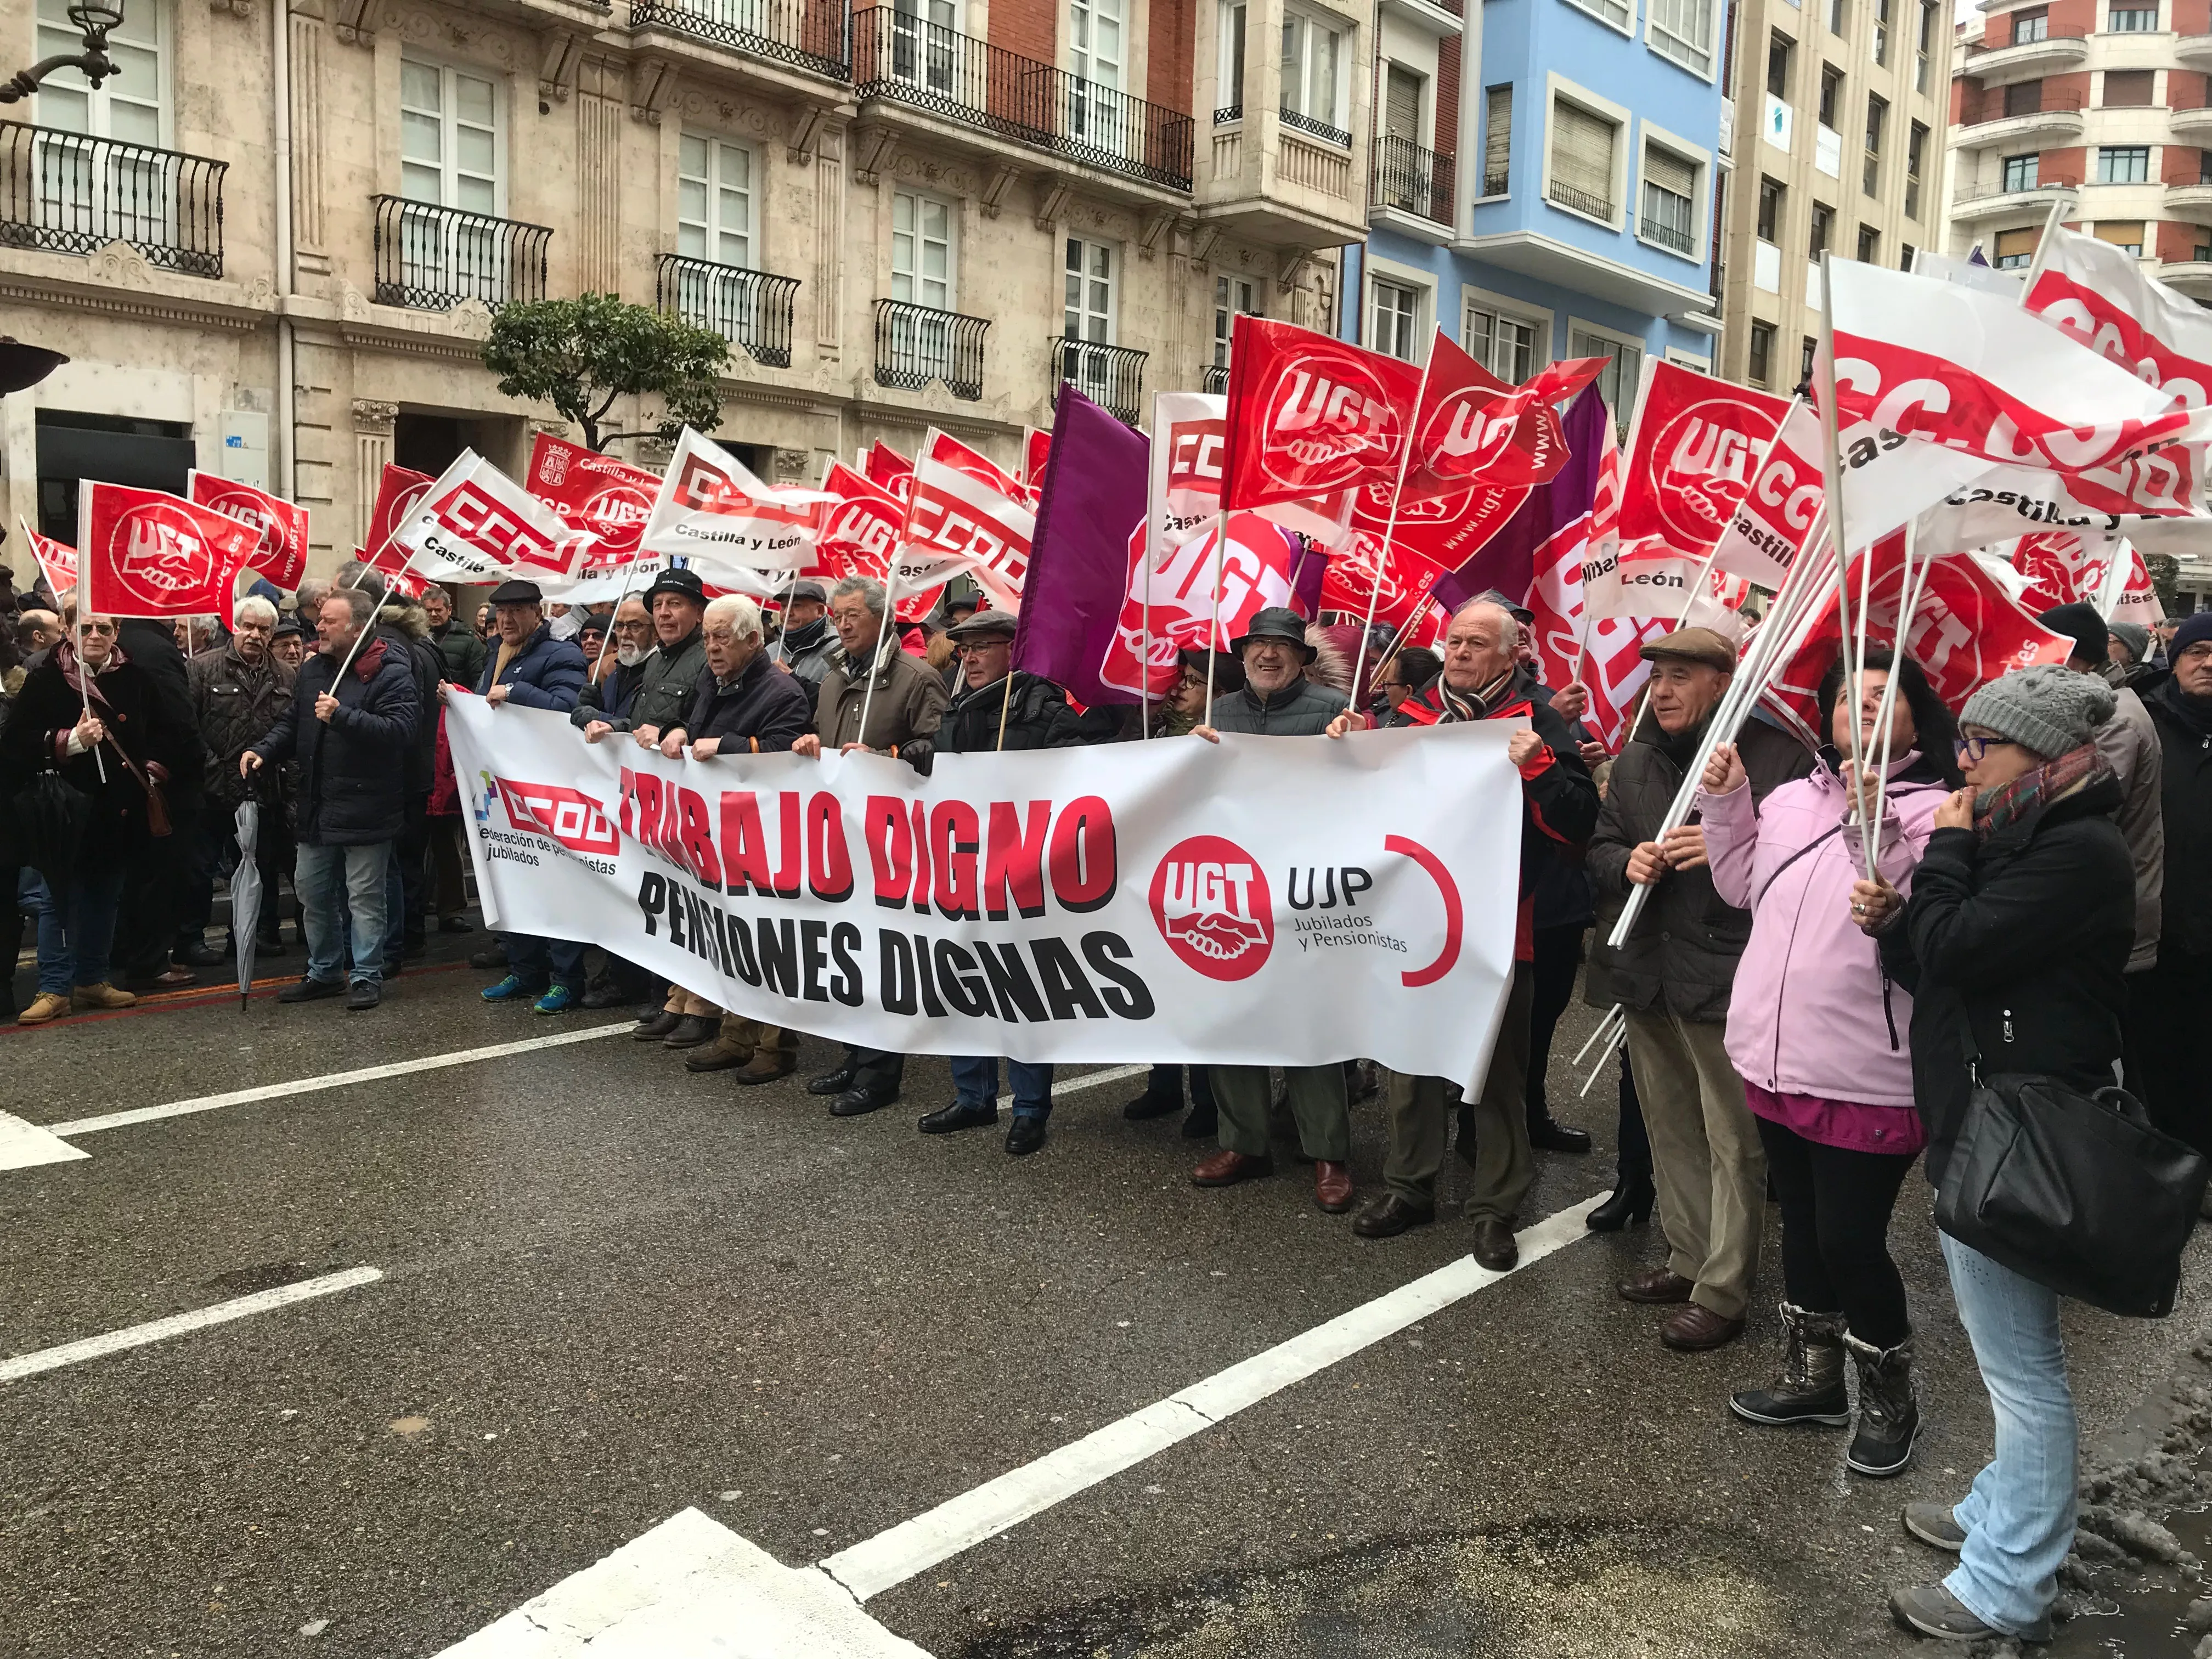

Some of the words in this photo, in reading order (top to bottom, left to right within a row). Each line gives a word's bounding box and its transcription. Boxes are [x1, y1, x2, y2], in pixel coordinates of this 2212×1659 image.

[1276, 365, 1390, 435] UGT
[1443, 399, 1520, 456] UG
[281, 512, 300, 582] www.UGT.es
[675, 524, 746, 545] Castilla
[750, 539, 763, 551] y
[768, 535, 801, 550] León
[1621, 571, 1683, 588] León
[477, 824, 534, 849] ederación
[537, 837, 551, 852] de
[486, 843, 540, 867] jubilados
[618, 766, 854, 903] TRABAJO
[865, 795, 1118, 922] DIGNO
[1163, 862, 1254, 920] UGT
[1288, 867, 1373, 911] UJP
[1294, 913, 1373, 932] Jubilados
[1298, 936, 1308, 952] y
[1314, 931, 1408, 953] Pensionistas
[637, 871, 864, 1007] PENSIONES
[879, 928, 1155, 1024] DIGNAS
